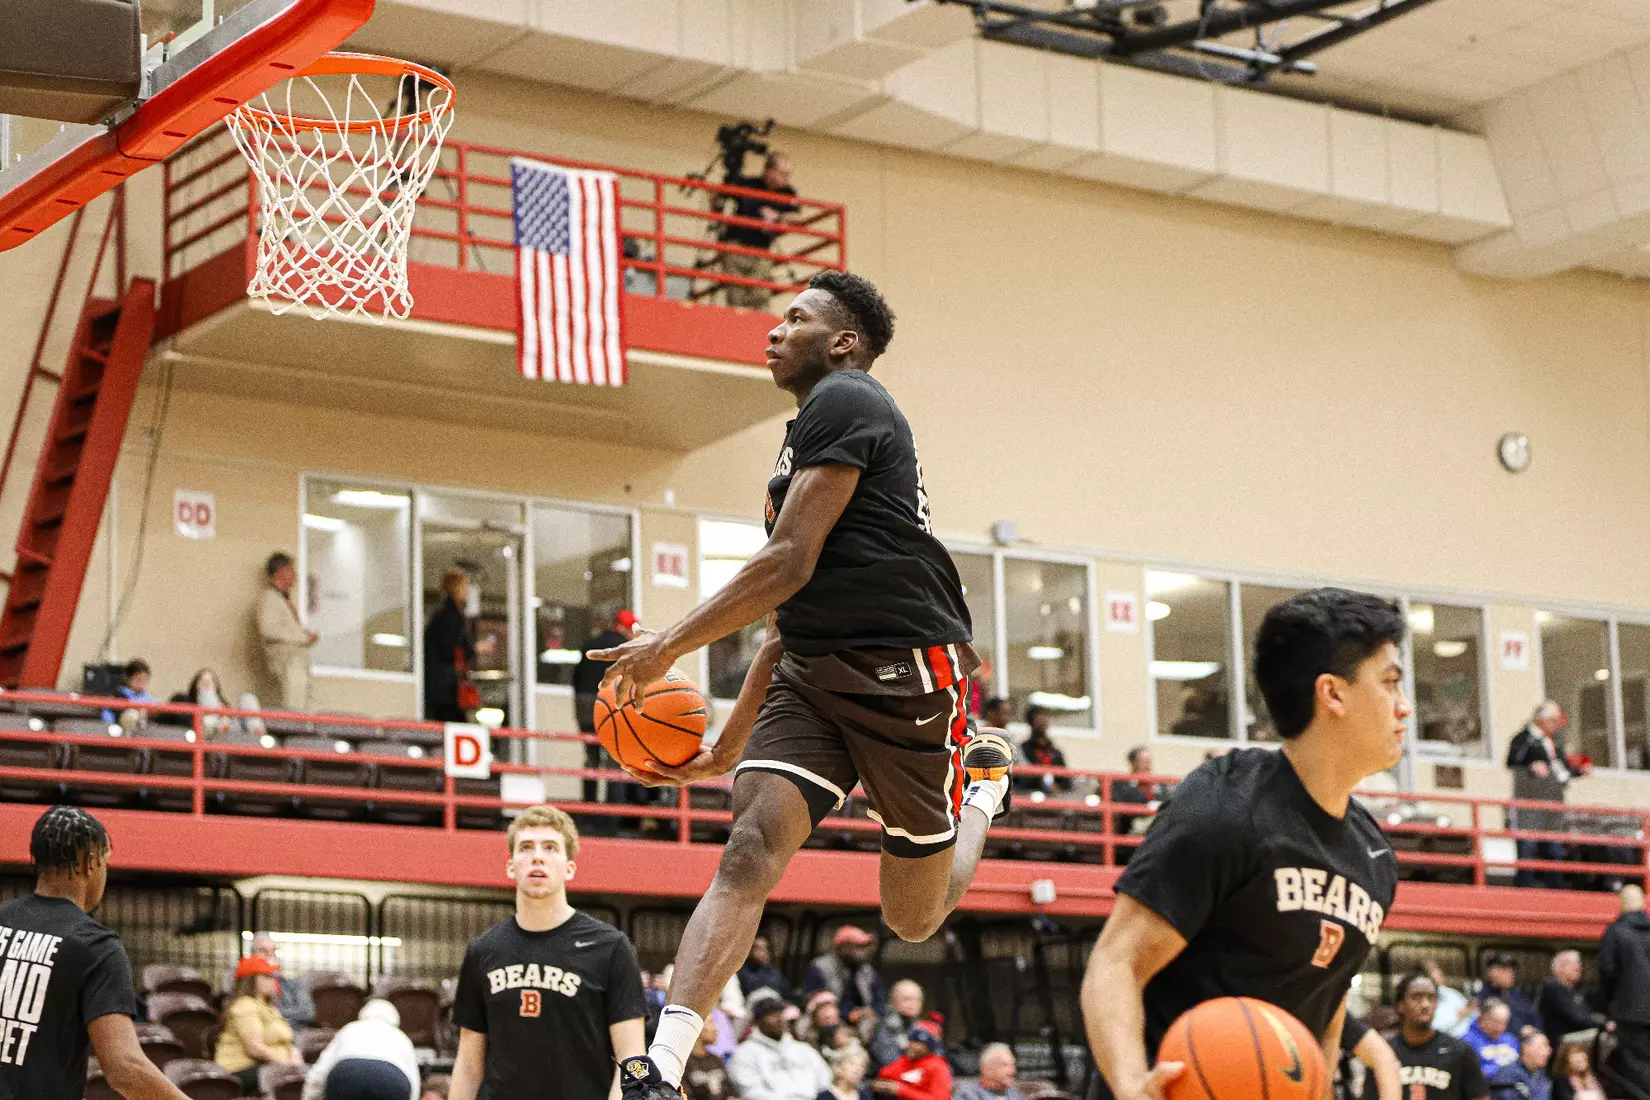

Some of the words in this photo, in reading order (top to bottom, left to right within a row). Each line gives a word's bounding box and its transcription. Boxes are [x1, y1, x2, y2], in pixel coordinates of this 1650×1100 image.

[177, 501, 211, 526] DD
[454, 735, 481, 767] D
[1273, 867, 1384, 945] BEARS
[7, 929, 63, 967] GAME
[487, 963, 582, 998] BEARS
[519, 989, 541, 1018] B
